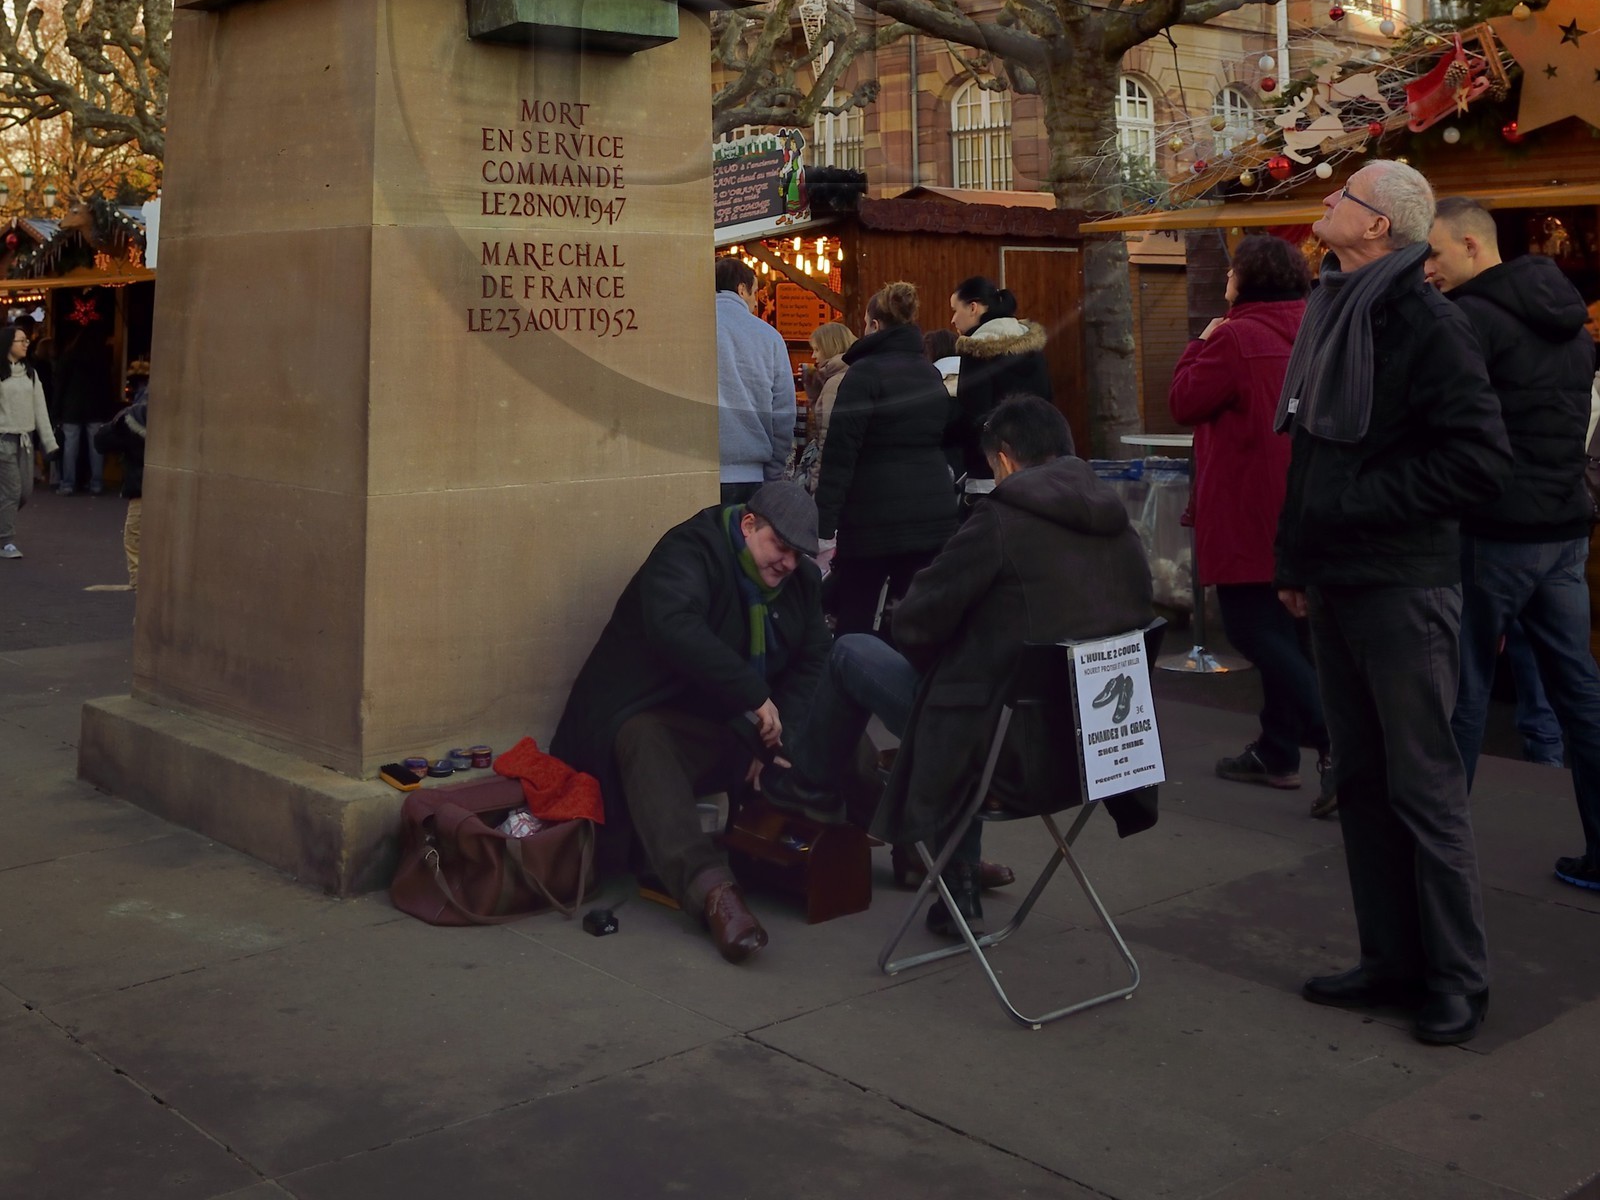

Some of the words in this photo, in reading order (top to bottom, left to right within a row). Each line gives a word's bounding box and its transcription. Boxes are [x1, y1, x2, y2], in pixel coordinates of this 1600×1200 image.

[521, 99, 590, 129] MORT
[482, 128, 513, 152] EN
[521, 130, 624, 160] SERVICE
[482, 160, 625, 190] COMMANDÉ
[481, 241, 626, 271] MARECHAL
[481, 275, 513, 299] DE
[524, 275, 625, 303] FRANCE
[1081, 650, 1113, 664] L'HUILE
[1118, 643, 1141, 657] COUDE
[1088, 727, 1119, 745] DEMANDEZ
[1120, 724, 1128, 737] UN
[1130, 719, 1152, 735] CIRAGE
[1098, 745, 1119, 756] SHOE
[1121, 738, 1144, 750] SHINE
[1114, 756, 1128, 765] ICI
